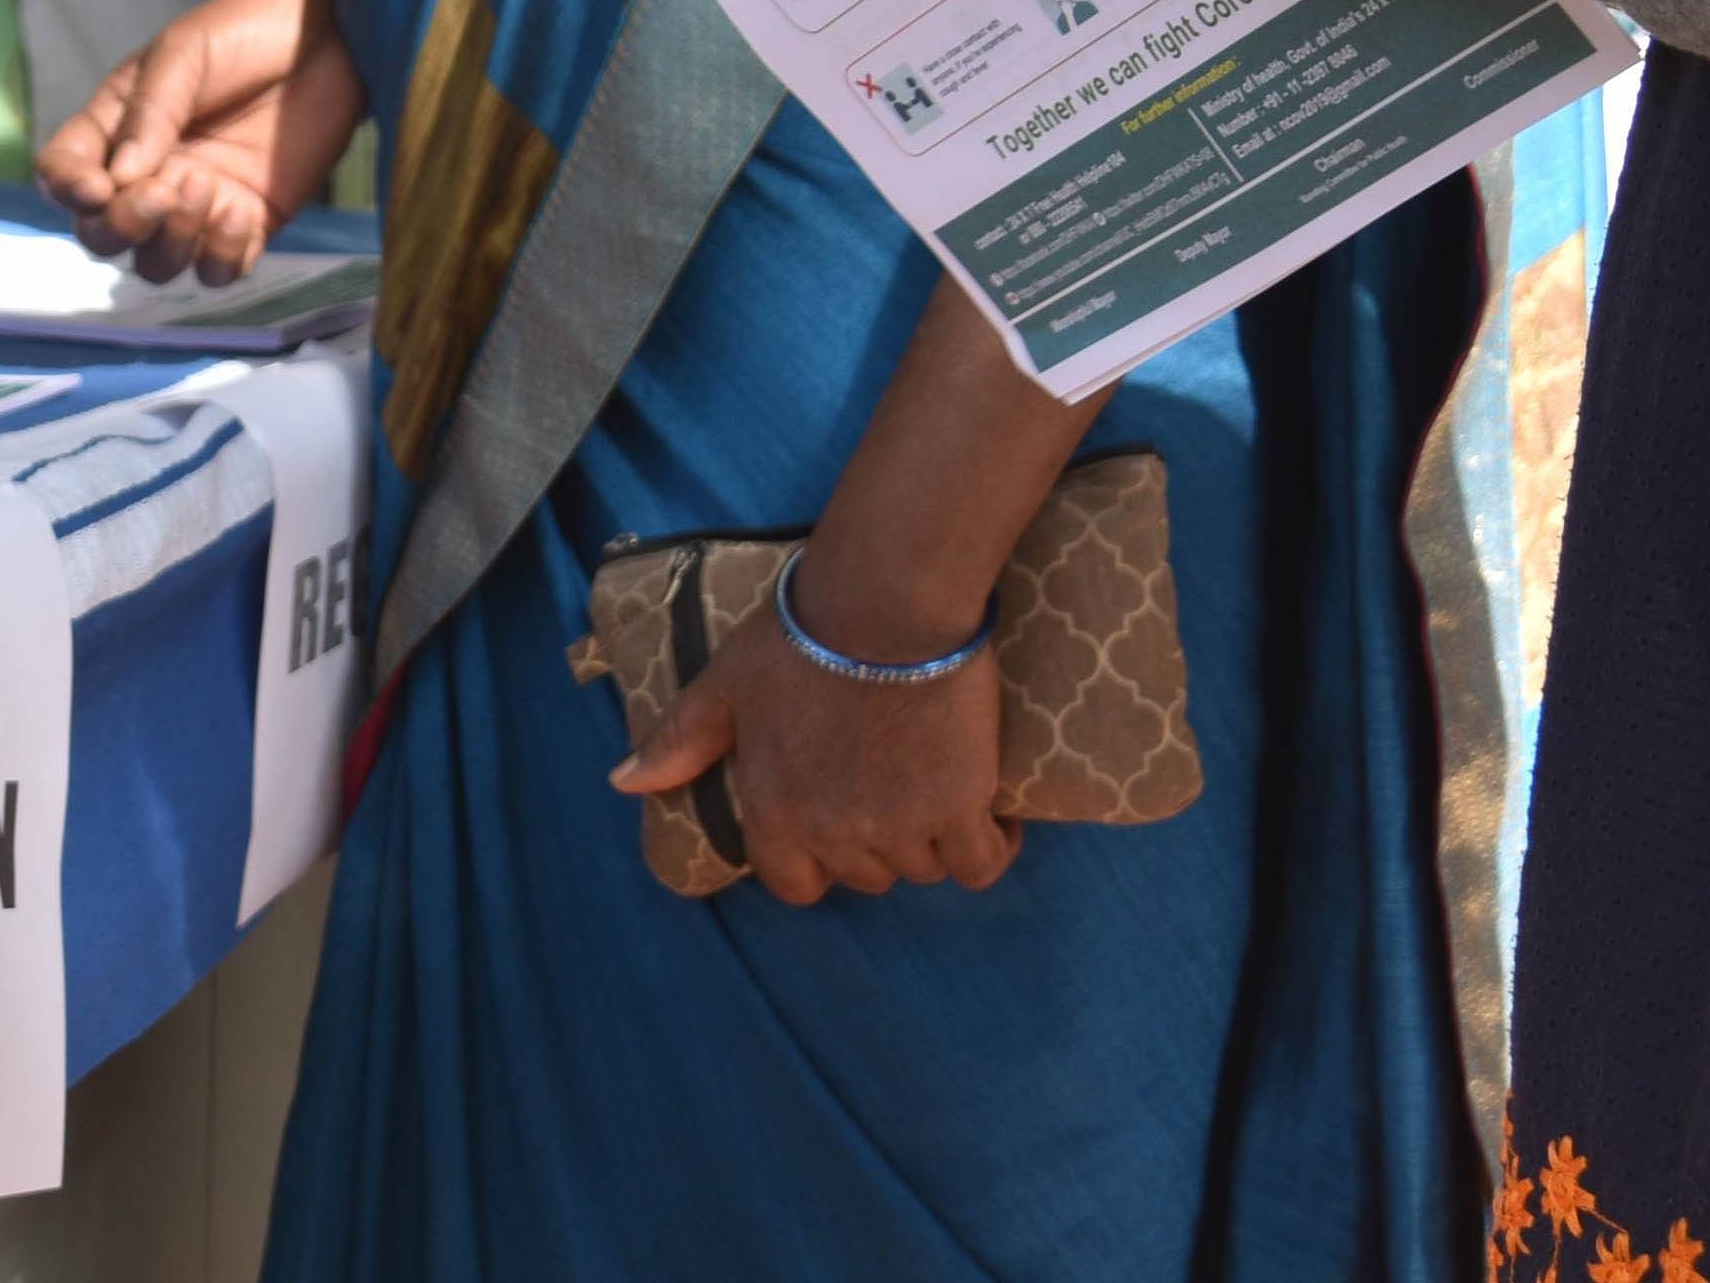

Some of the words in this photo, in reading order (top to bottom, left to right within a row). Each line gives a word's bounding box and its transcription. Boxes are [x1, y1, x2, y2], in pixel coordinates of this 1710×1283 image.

[945, 45, 962, 58] close
[961, 28, 987, 47] contact
[985, 18, 1000, 31] with
[939, 80, 961, 98] cough
[959, 71, 973, 83] and
[971, 60, 990, 75] fever
[1200, 85, 1245, 118] Ministry
[1238, 77, 1255, 91] of
[1249, 55, 1290, 84] health,
[1284, 37, 1317, 63] Govt.
[1312, 29, 1329, 45] of
[1323, 7, 1365, 38] India's
[1463, 39, 1541, 88] Commissioner
[986, 94, 1084, 161] Together
[1077, 78, 1109, 106] we
[1108, 53, 1148, 86] can
[1141, 15, 1197, 70] fight
[1122, 119, 1139, 135] For
[1138, 97, 1174, 127] further
[1171, 59, 1236, 105] information
[1230, 131, 1265, 158] Email
[1273, 54, 1395, 132] ncov2019@gmail.com
[1215, 106, 1259, 136] Number
[1313, 137, 1365, 170] Chairman
[1203, 224, 1233, 248] Mayor
